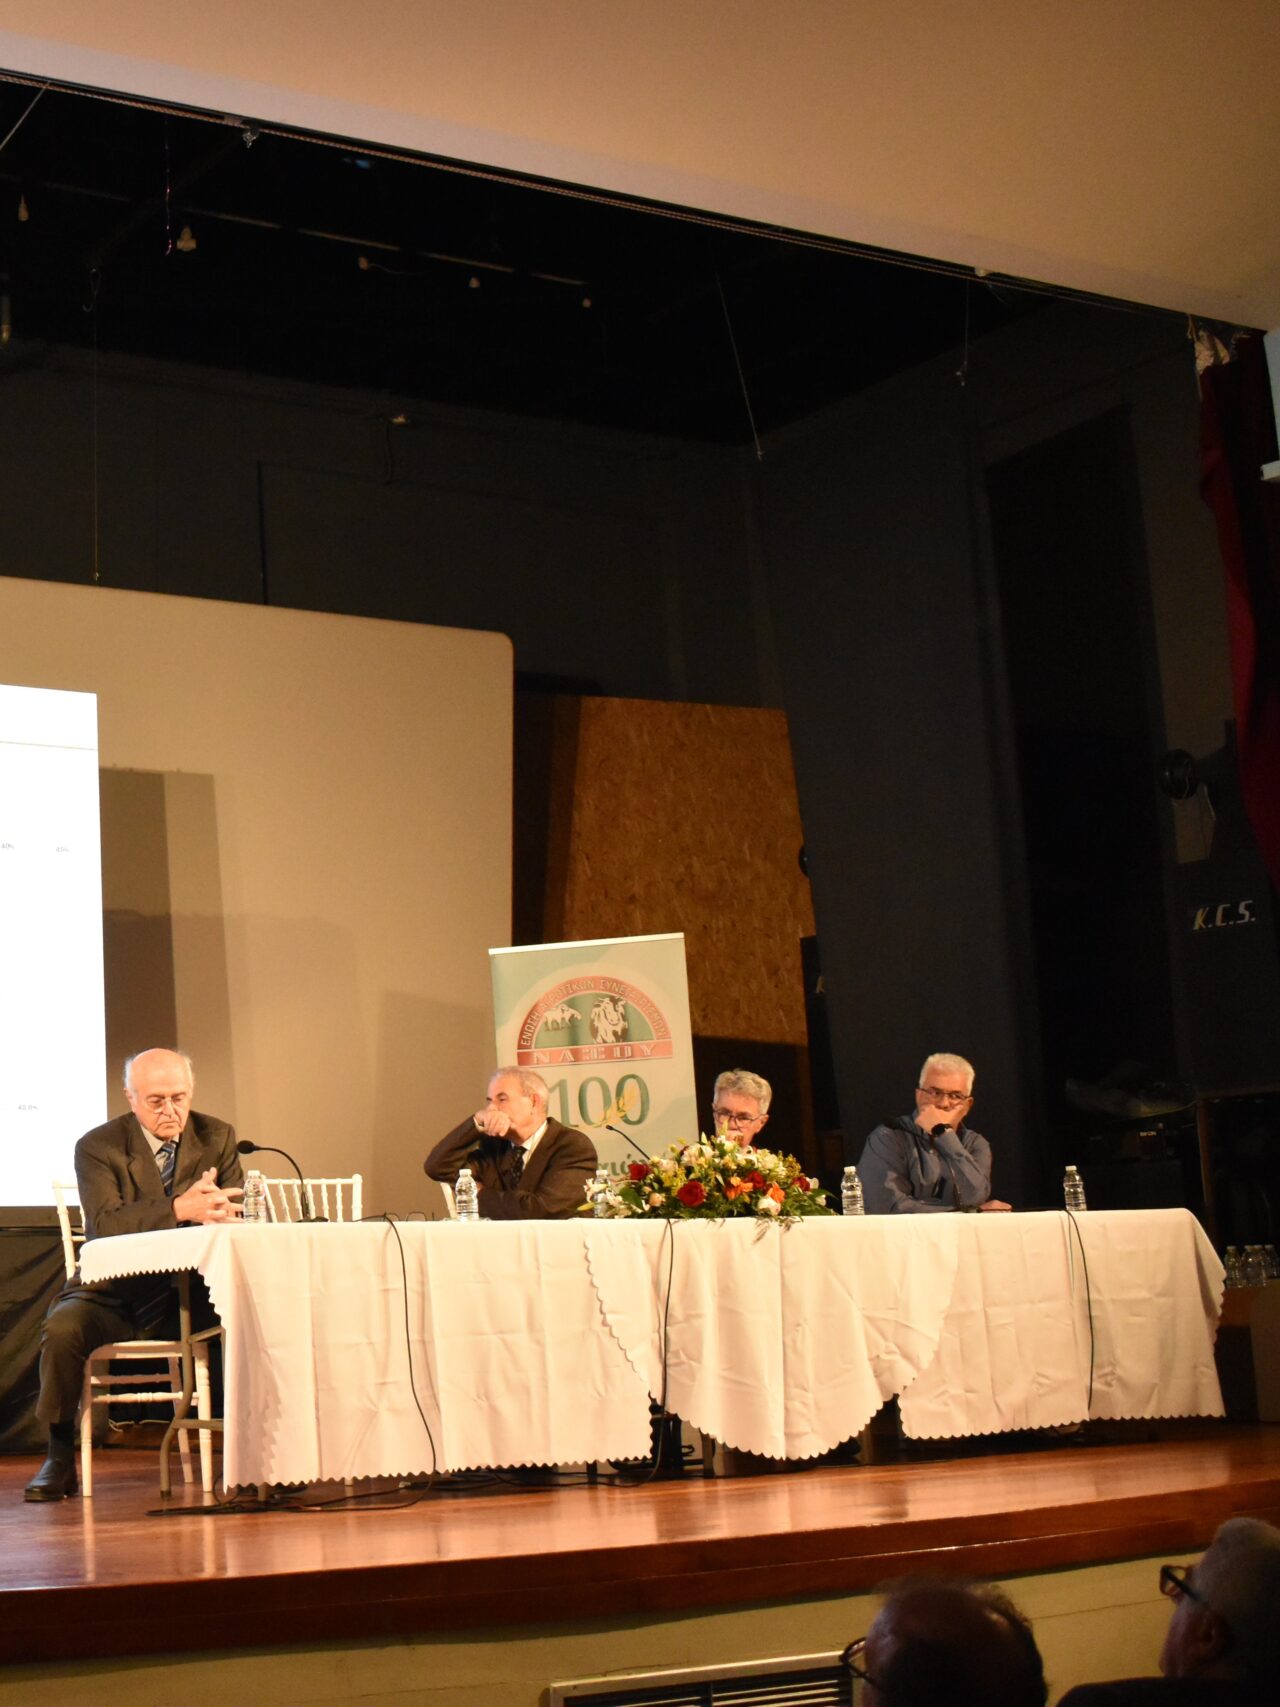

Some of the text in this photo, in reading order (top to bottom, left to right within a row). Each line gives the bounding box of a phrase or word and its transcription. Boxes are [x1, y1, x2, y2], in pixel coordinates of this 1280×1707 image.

[1193, 900, 1256, 930] K.C.S.
[521, 1011, 542, 1046] ΕΝΩΣΗ
[534, 1044, 657, 1064] ΝΑΞΟΥ
[548, 1074, 650, 1128] 100
